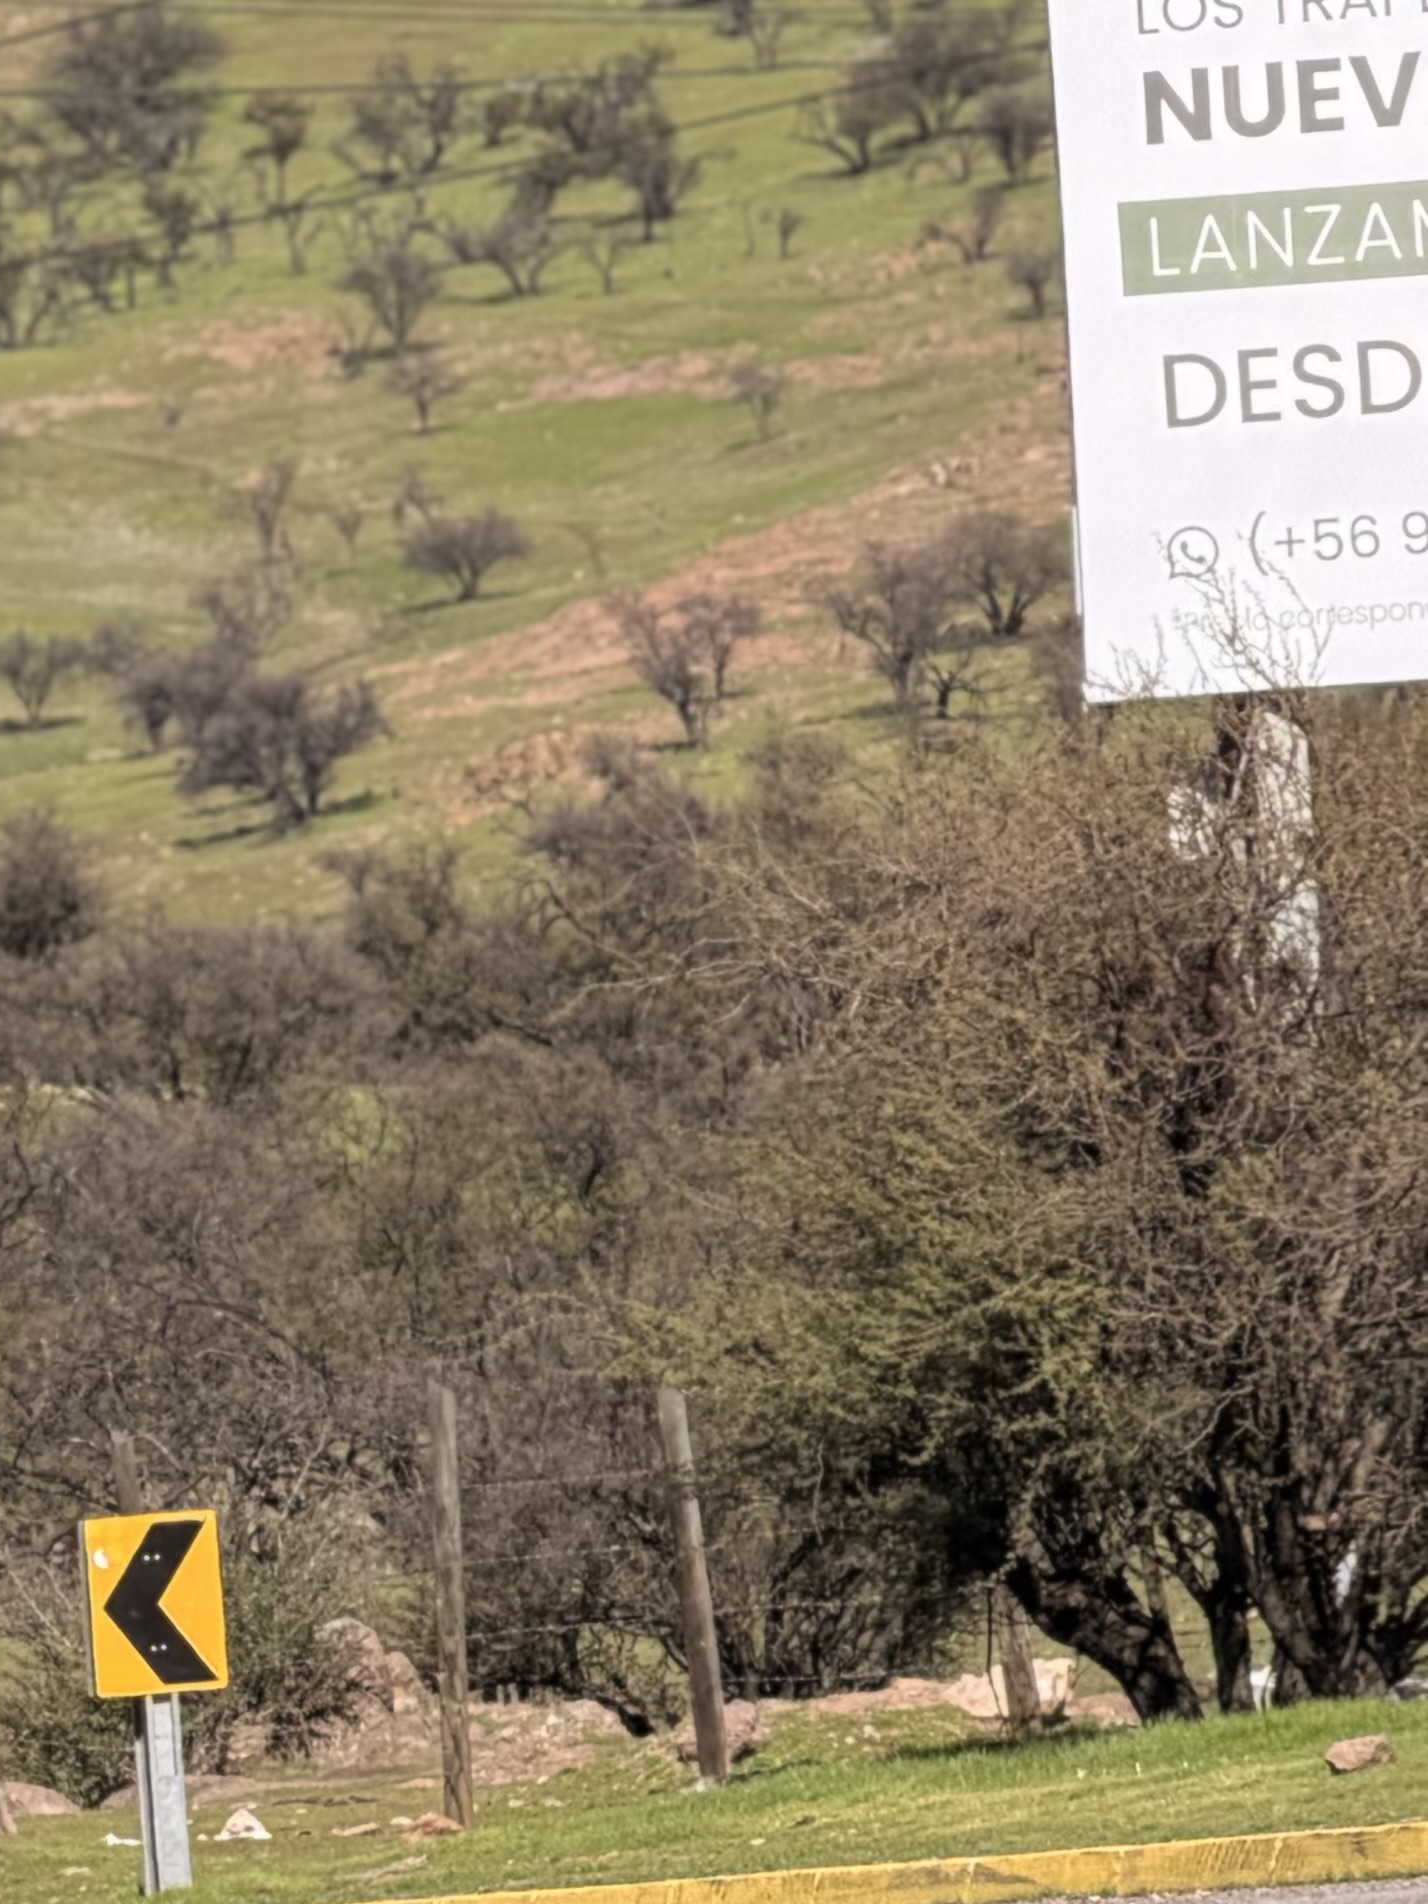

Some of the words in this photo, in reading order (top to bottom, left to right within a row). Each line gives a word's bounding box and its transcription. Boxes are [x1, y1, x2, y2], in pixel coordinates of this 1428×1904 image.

[1162, 339, 1423, 429] DESD
[1248, 509, 1381, 577] (+56
[1278, 599, 1428, 631] correspon
